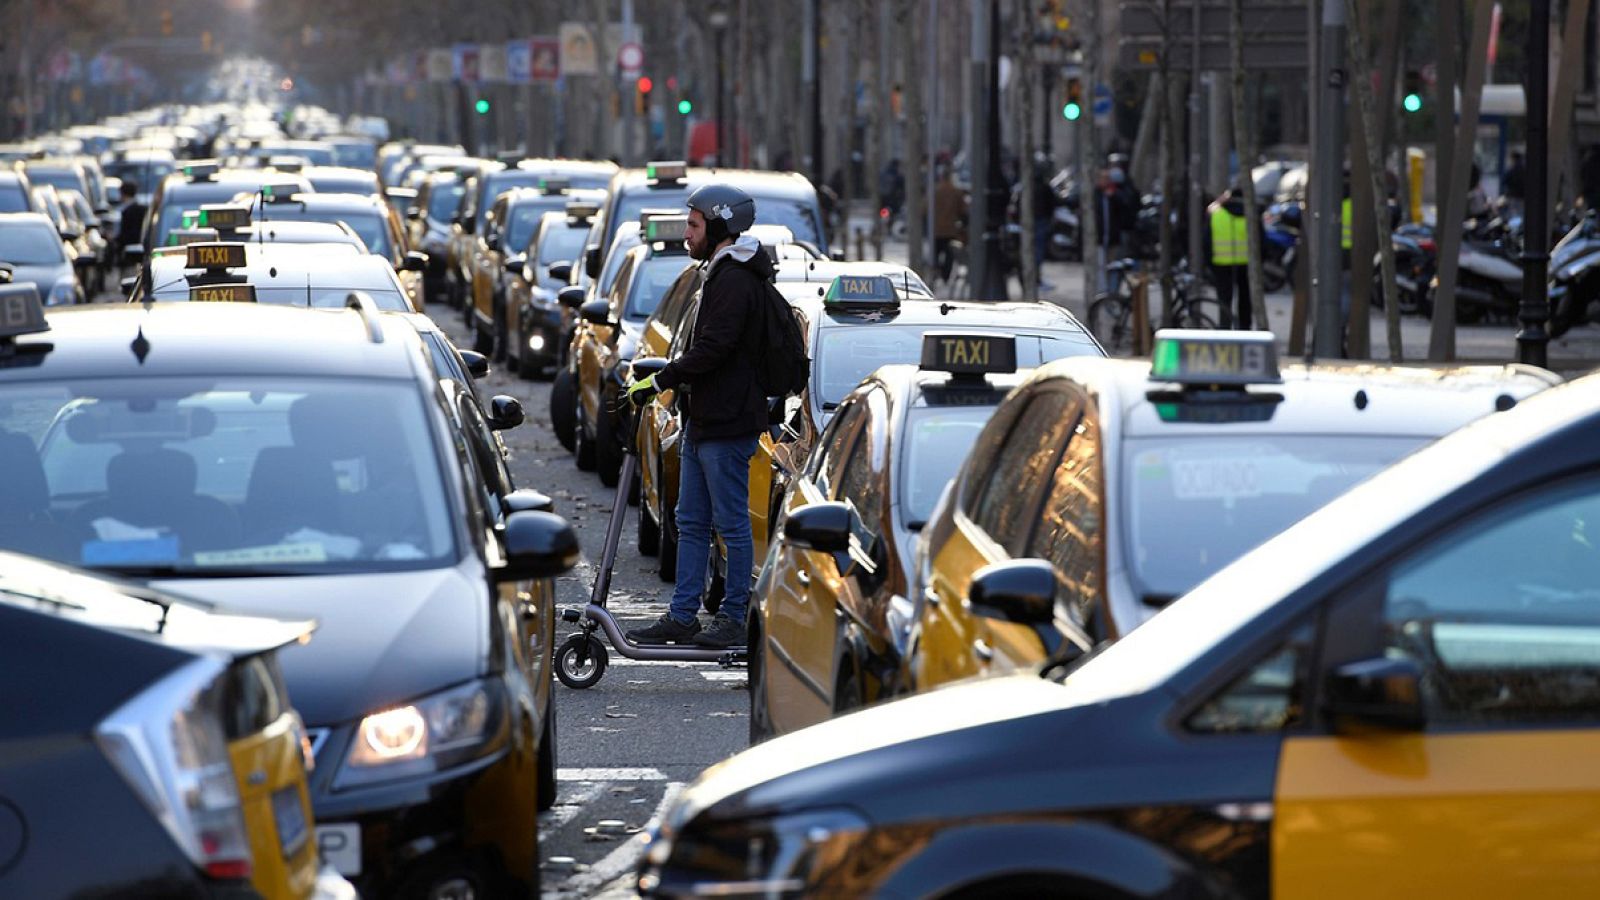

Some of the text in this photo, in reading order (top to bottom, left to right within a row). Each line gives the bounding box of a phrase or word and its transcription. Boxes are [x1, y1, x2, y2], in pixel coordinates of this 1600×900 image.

[197, 247, 230, 264] TAXI
[200, 289, 235, 302] TAXI
[842, 279, 873, 295] TAXI
[941, 339, 990, 366] TAXI
[1184, 343, 1241, 374] TAXI
[318, 831, 348, 866] P
